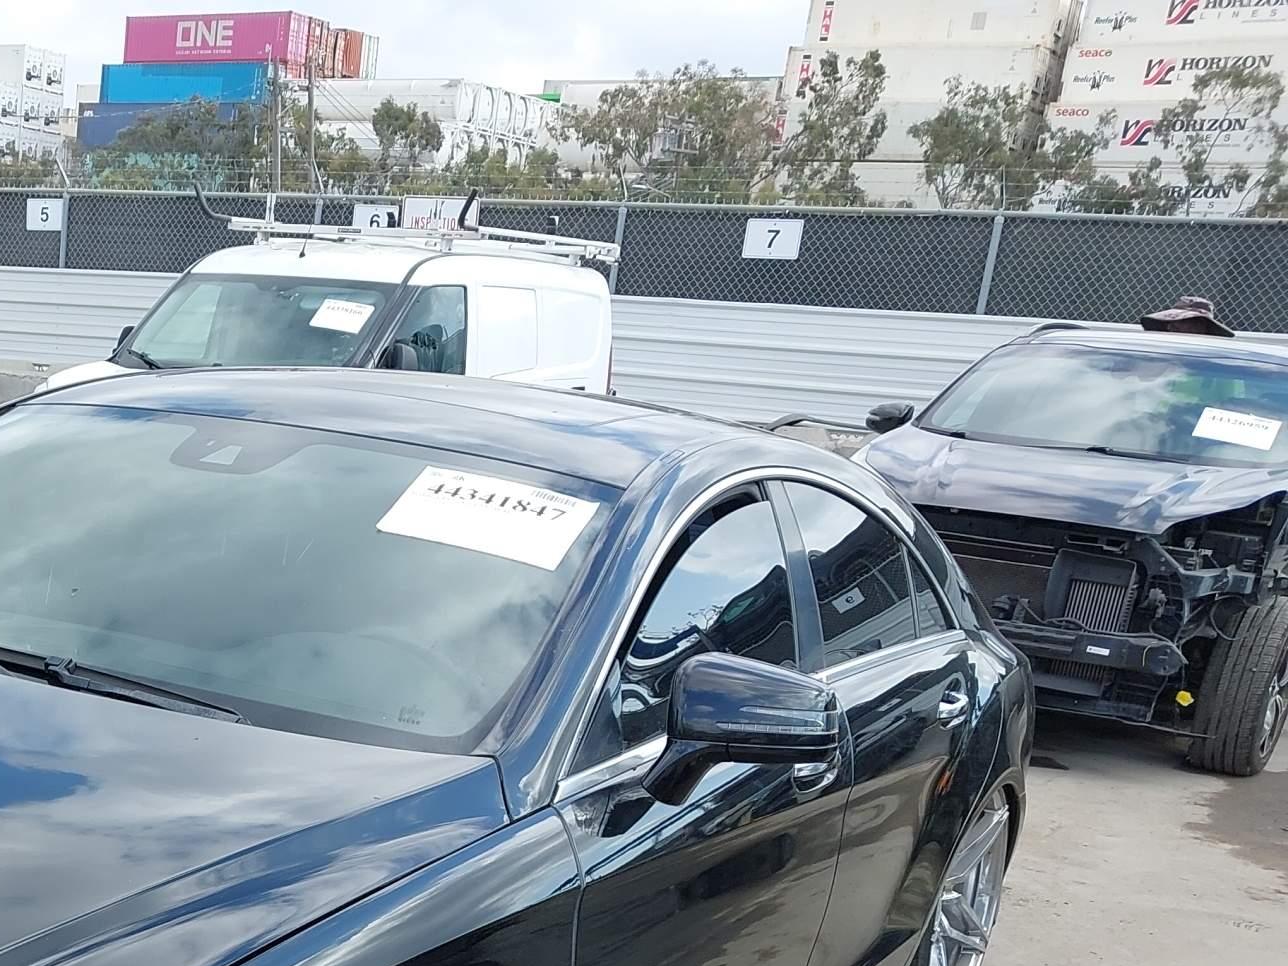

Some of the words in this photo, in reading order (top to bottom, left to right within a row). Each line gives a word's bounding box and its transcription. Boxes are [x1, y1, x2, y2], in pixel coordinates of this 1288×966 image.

[1203, 0, 1288, 9] HORIZO
[1200, 9, 1277, 19] LINES
[176, 20, 234, 47] ONE
[1078, 48, 1113, 58] seaco
[1179, 54, 1274, 71] HORIZON
[1055, 106, 1090, 117] seaco
[1157, 118, 1249, 132] ORIZON
[40, 206, 49, 222] 5
[369, 213, 380, 227] 6
[767, 229, 781, 248] 7
[427, 483, 567, 521] 44341847
